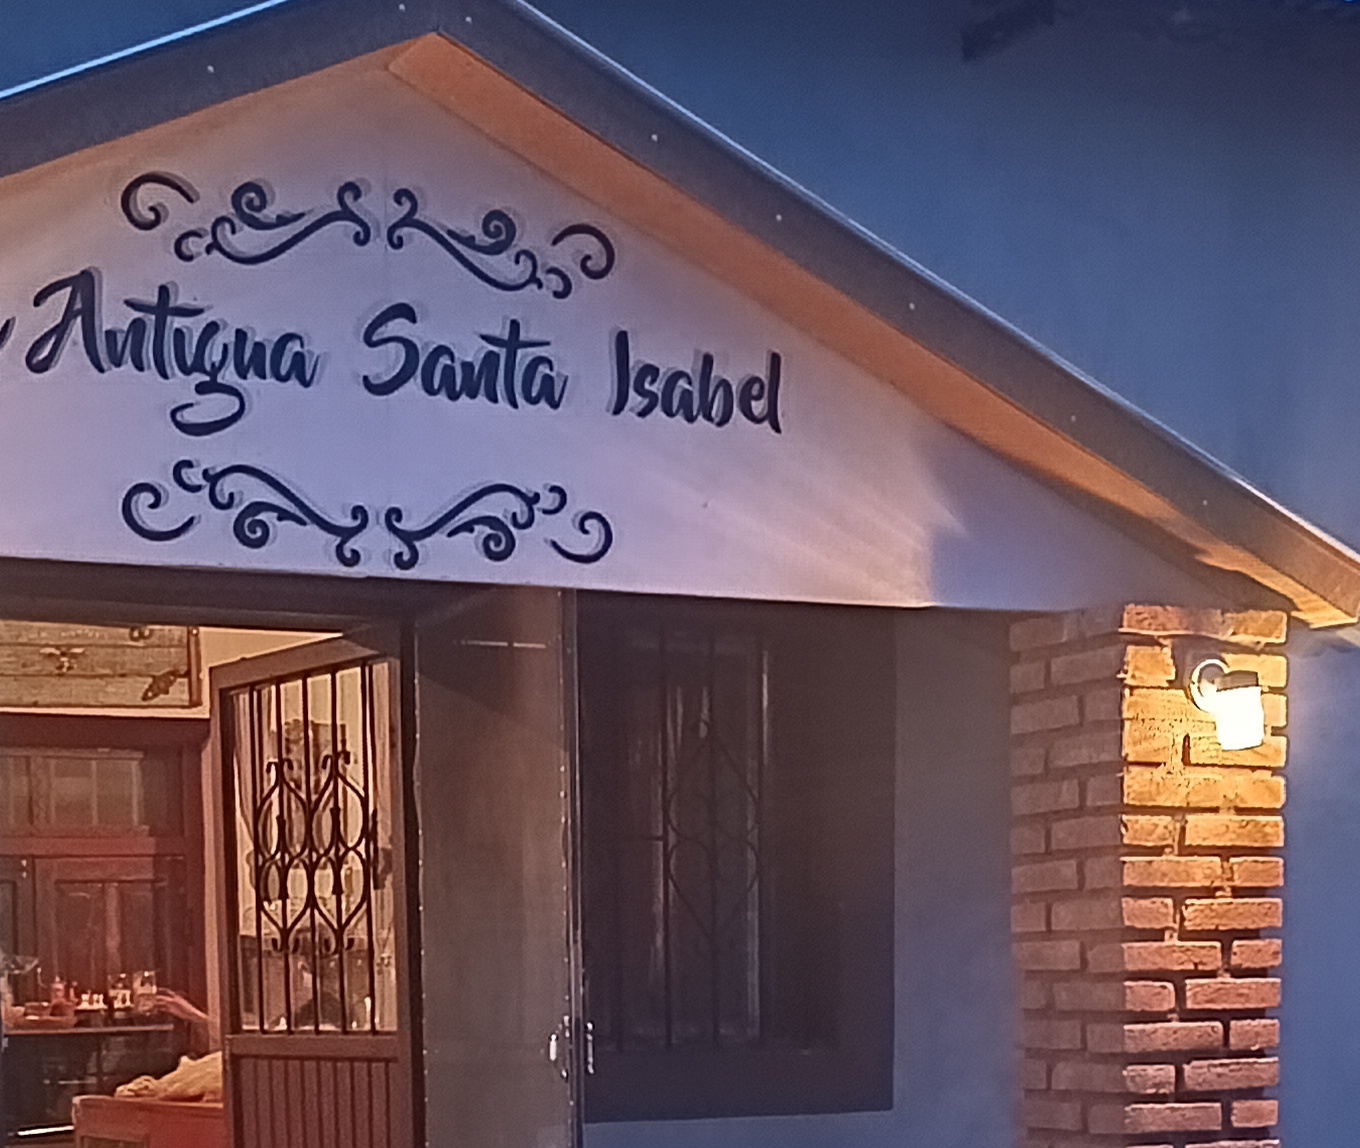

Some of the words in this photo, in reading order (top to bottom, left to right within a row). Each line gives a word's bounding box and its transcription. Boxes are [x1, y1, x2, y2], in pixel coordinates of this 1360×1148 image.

[25, 268, 320, 437] Antigua
[361, 302, 570, 412] Santa
[611, 329, 783, 435] Isabel
